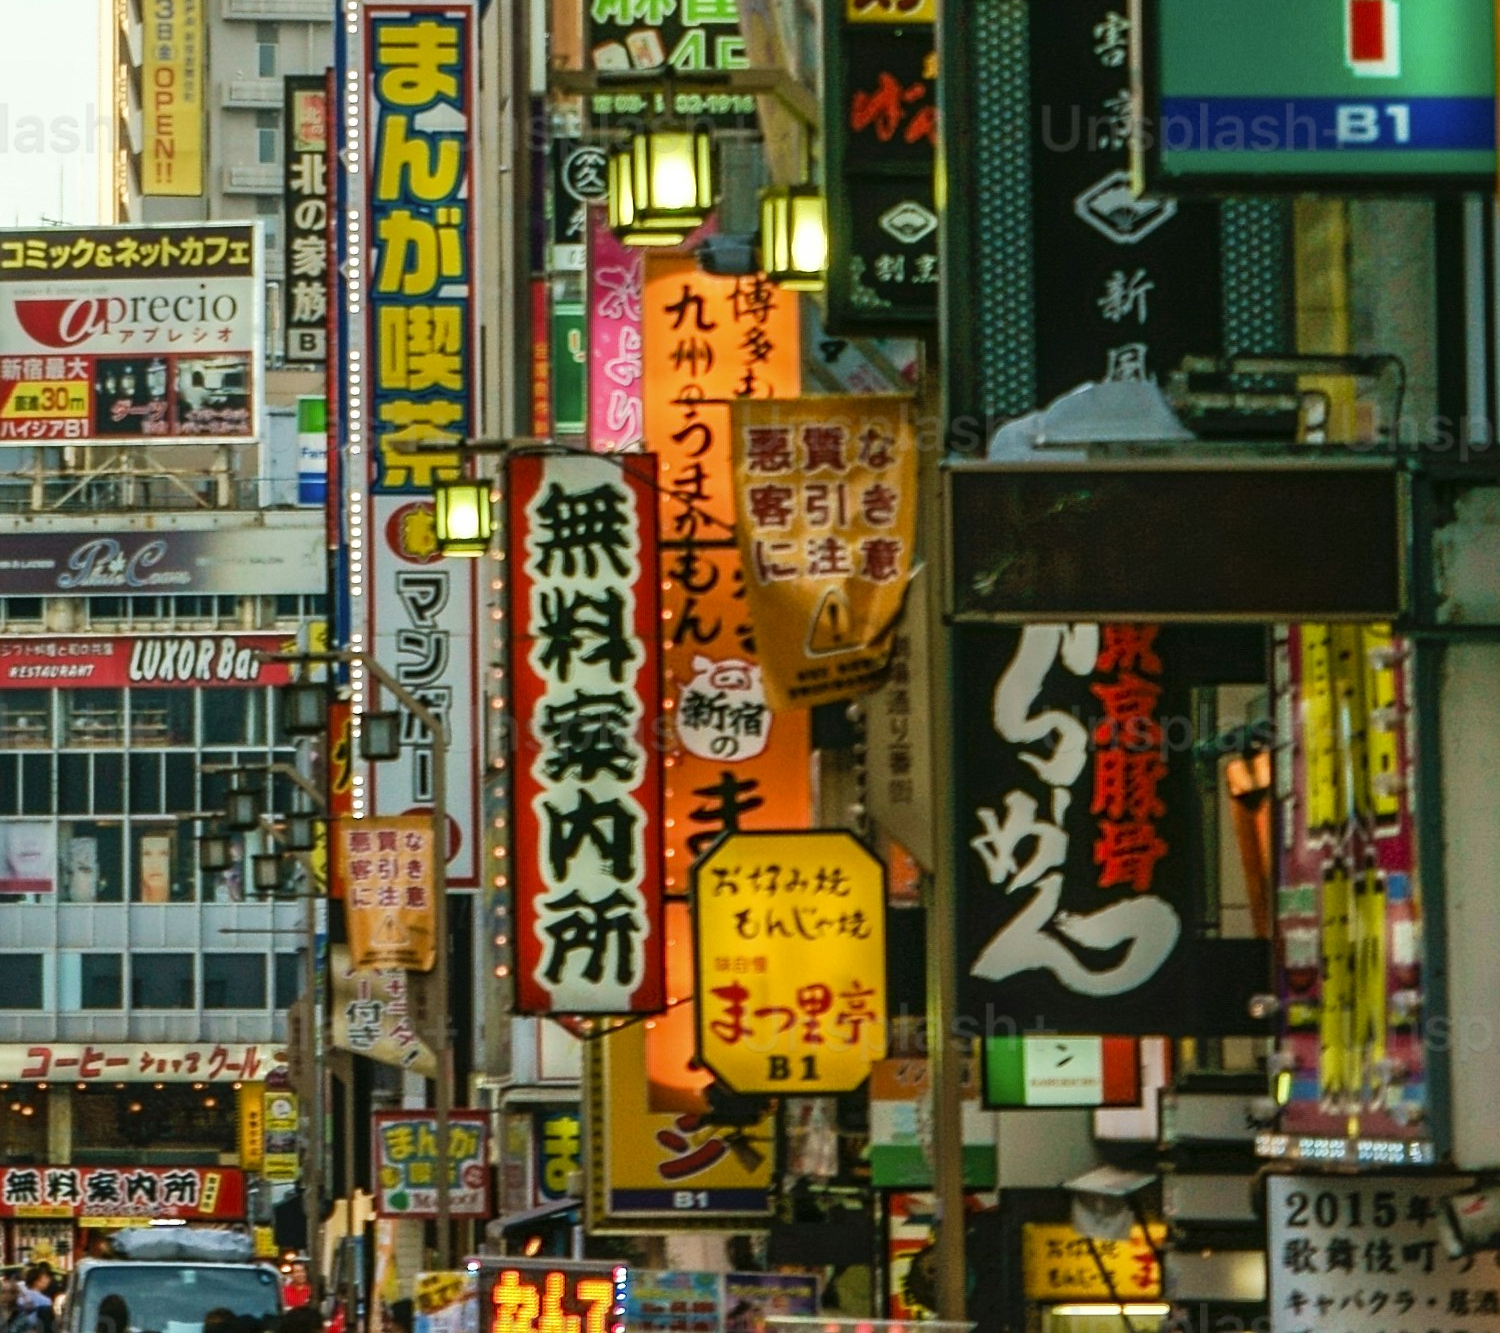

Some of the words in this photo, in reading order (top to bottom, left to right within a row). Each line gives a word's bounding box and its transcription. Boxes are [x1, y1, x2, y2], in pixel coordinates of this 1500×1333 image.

[1333, 105, 1413, 143] B1
[1, 236, 251, 270] コミック&ネットカフェ
[289, 157, 329, 322] 北の家族
[373, 20, 465, 489] まんが喫茶
[1, 357, 90, 381] 新宿最大
[747, 425, 895, 473] 悪質な
[749, 483, 899, 530] 客引き
[754, 537, 902, 586] に注意
[129, 638, 215, 681] LUXOR
[531, 479, 645, 988] 無料案内所
[681, 691, 764, 738] 新宿
[348, 830, 424, 854] 悪質な
[350, 858, 425, 882] 客引き
[709, 864, 852, 898] お好み焼
[352, 884, 427, 909] に注意
[20, 1046, 130, 1079] コーヒー
[207, 1045, 262, 1080] クール
[767, 1055, 824, 1082] B1
[1, 1167, 200, 1207] 無料案内所
[673, 1191, 710, 1210] B1
